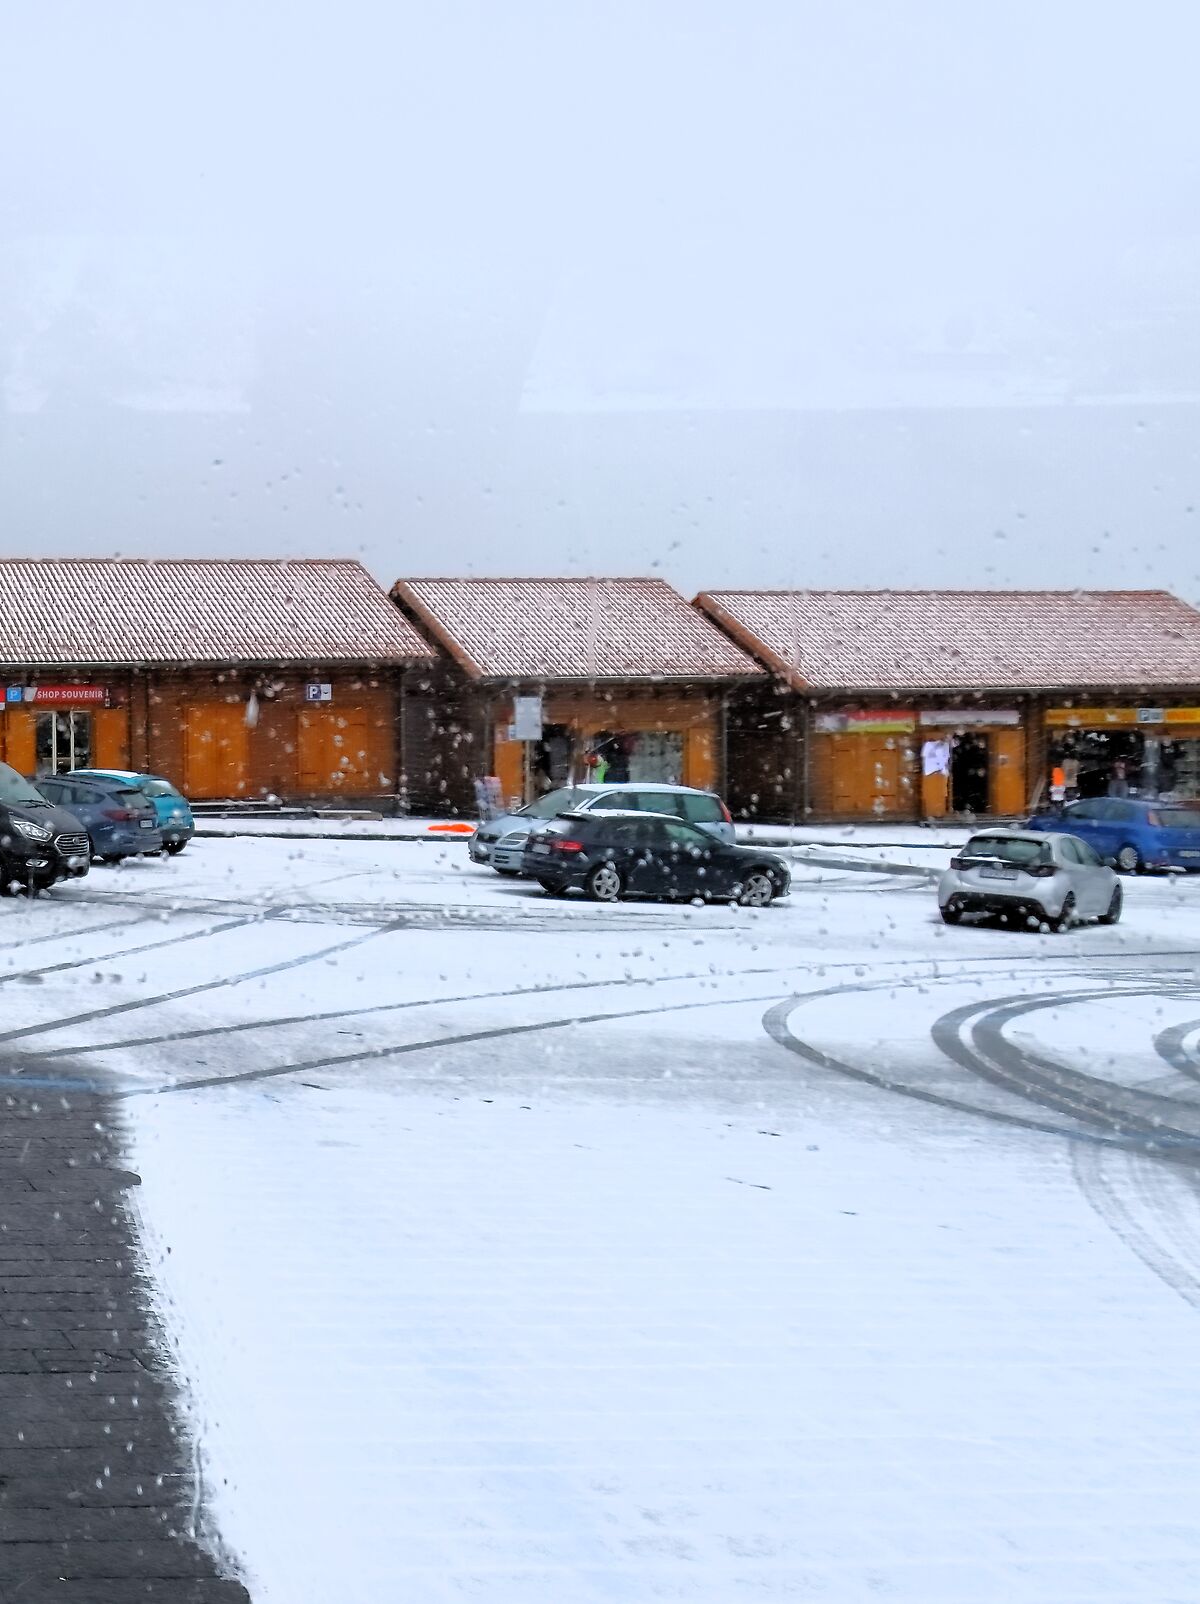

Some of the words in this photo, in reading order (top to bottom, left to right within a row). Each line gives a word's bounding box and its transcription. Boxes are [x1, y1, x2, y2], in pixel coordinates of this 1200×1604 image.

[10, 690, 18, 699] P
[62, 690, 103, 698] SOUVENIR
[310, 686, 318, 698] P
